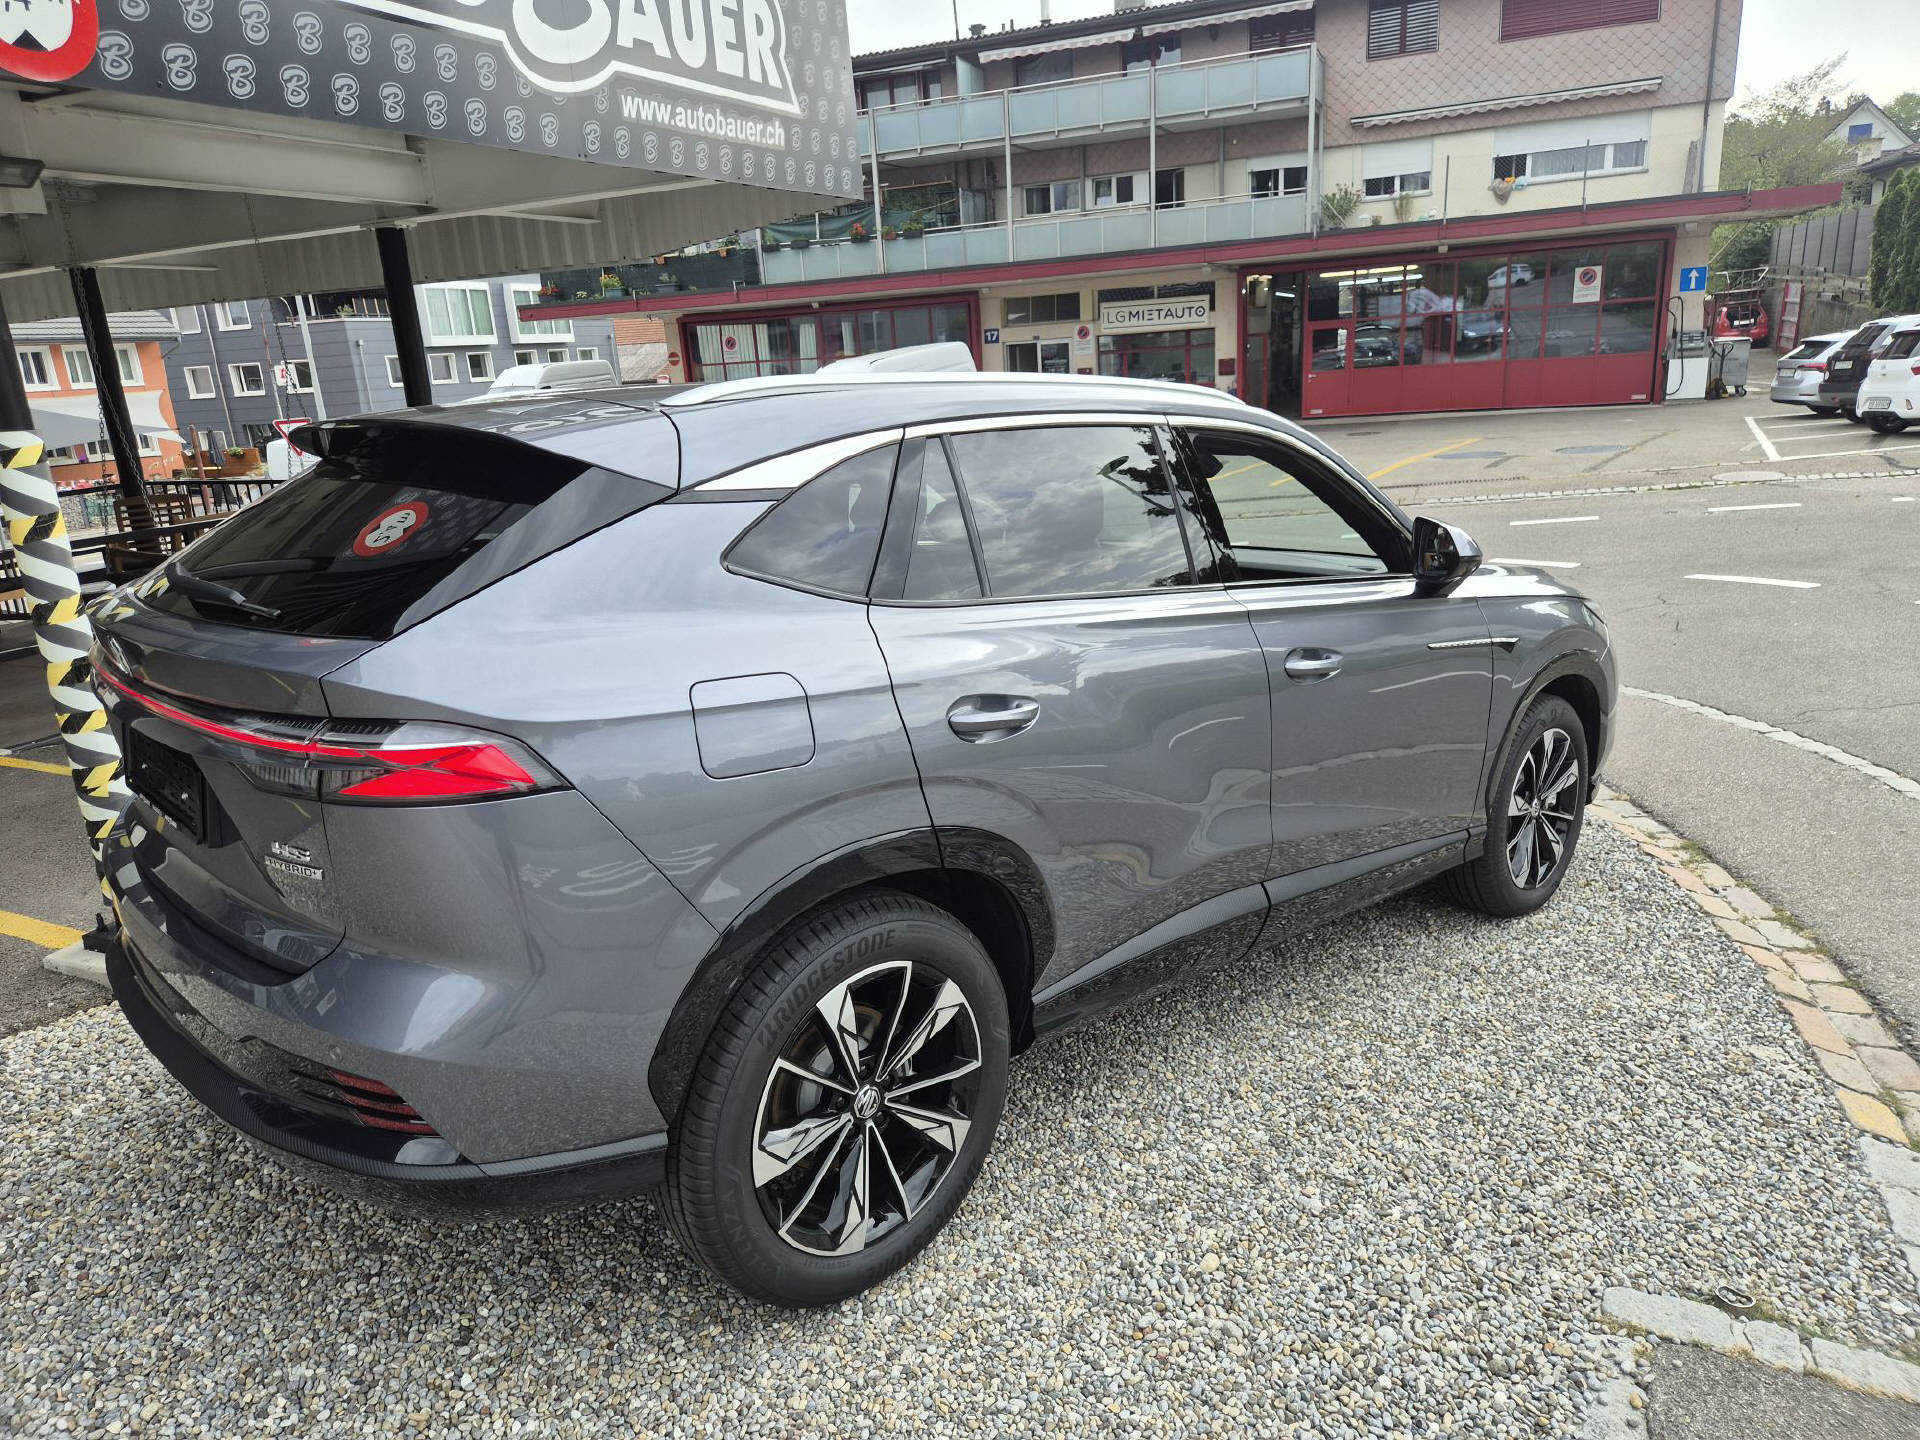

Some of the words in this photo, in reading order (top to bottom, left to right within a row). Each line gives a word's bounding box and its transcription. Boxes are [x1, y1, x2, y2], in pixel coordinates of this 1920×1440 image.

[621, 94, 786, 147] www.autobauer.ch
[986, 330, 998, 342] 17
[757, 928, 897, 1049] BRIDGESTONE
